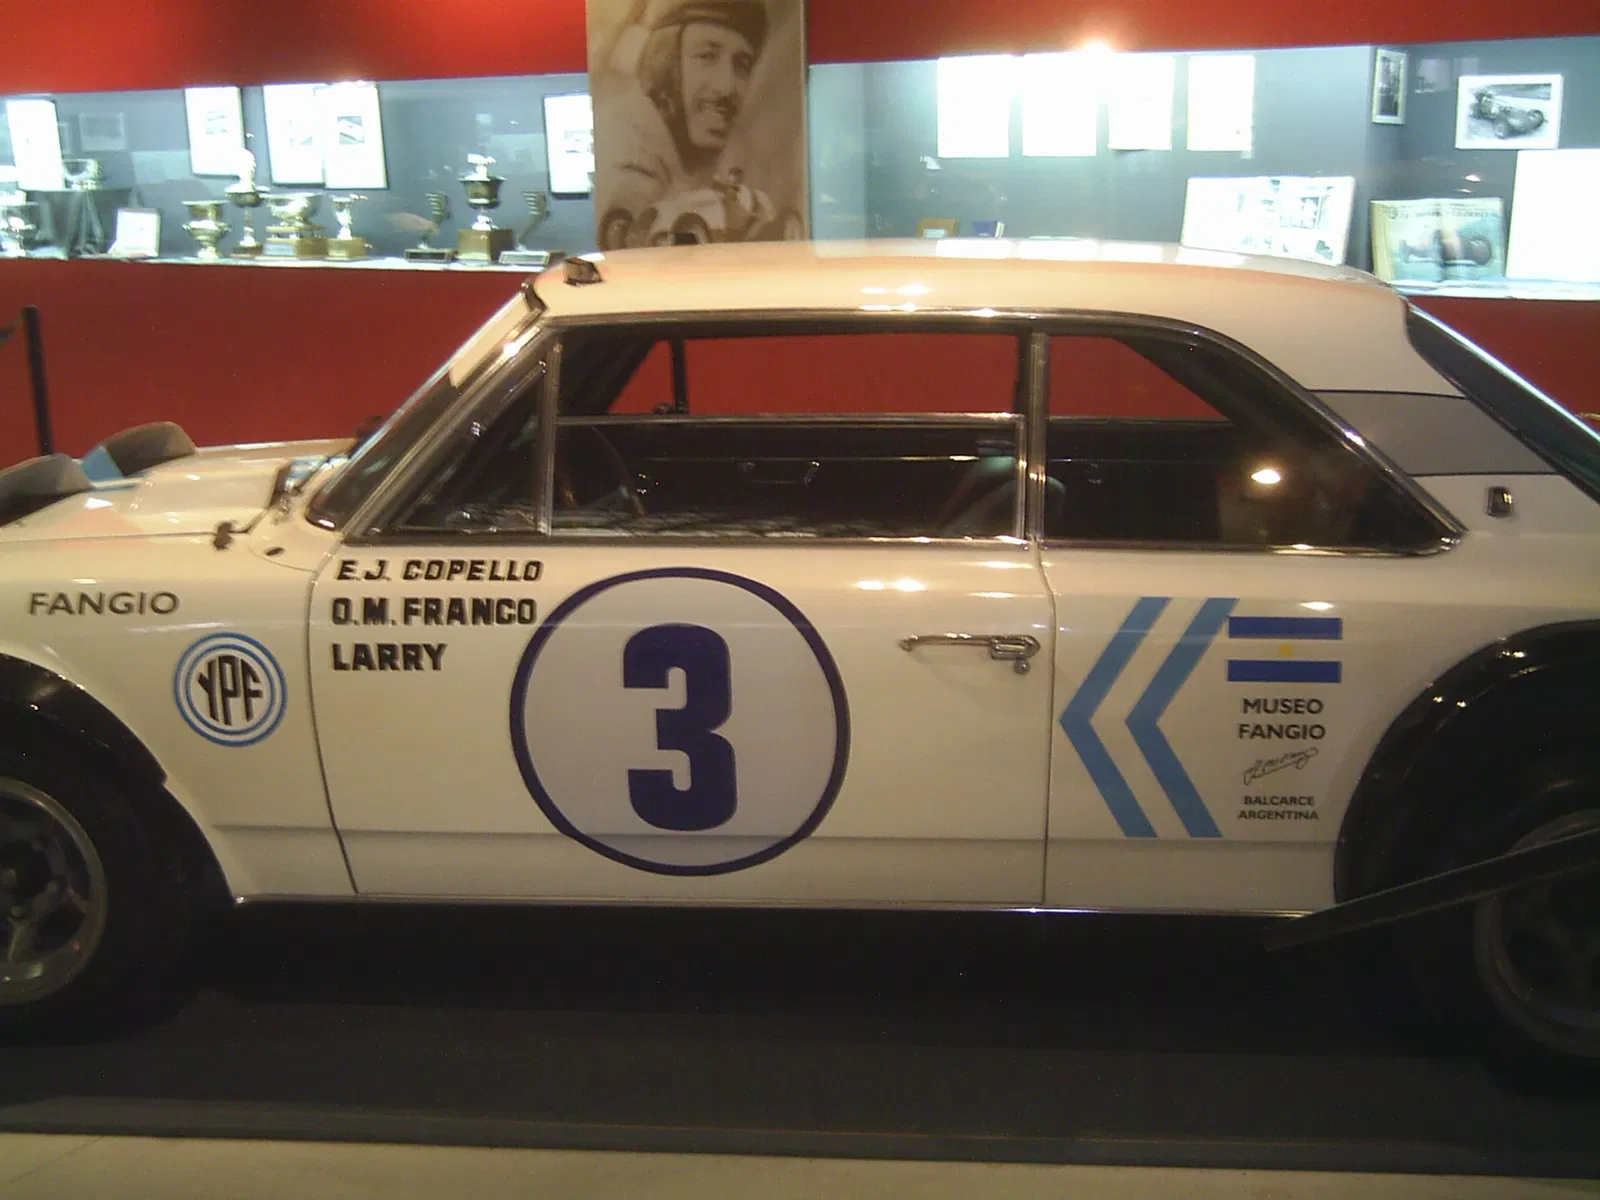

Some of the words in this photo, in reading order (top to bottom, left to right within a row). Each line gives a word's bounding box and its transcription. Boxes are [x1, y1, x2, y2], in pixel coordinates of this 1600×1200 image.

[337, 559, 391, 581] E.J.
[403, 559, 543, 581] COPELLO
[29, 592, 180, 615] FANGIO
[402, 597, 537, 626] FRANCO
[332, 643, 447, 671] LARRY
[197, 655, 263, 726] YPF
[1242, 698, 1324, 715] MUSEO
[622, 622, 738, 831] 3
[1238, 723, 1326, 740] FANGIO
[1243, 795, 1315, 806] BALCARCE
[1237, 810, 1319, 821] ARGENTINA
